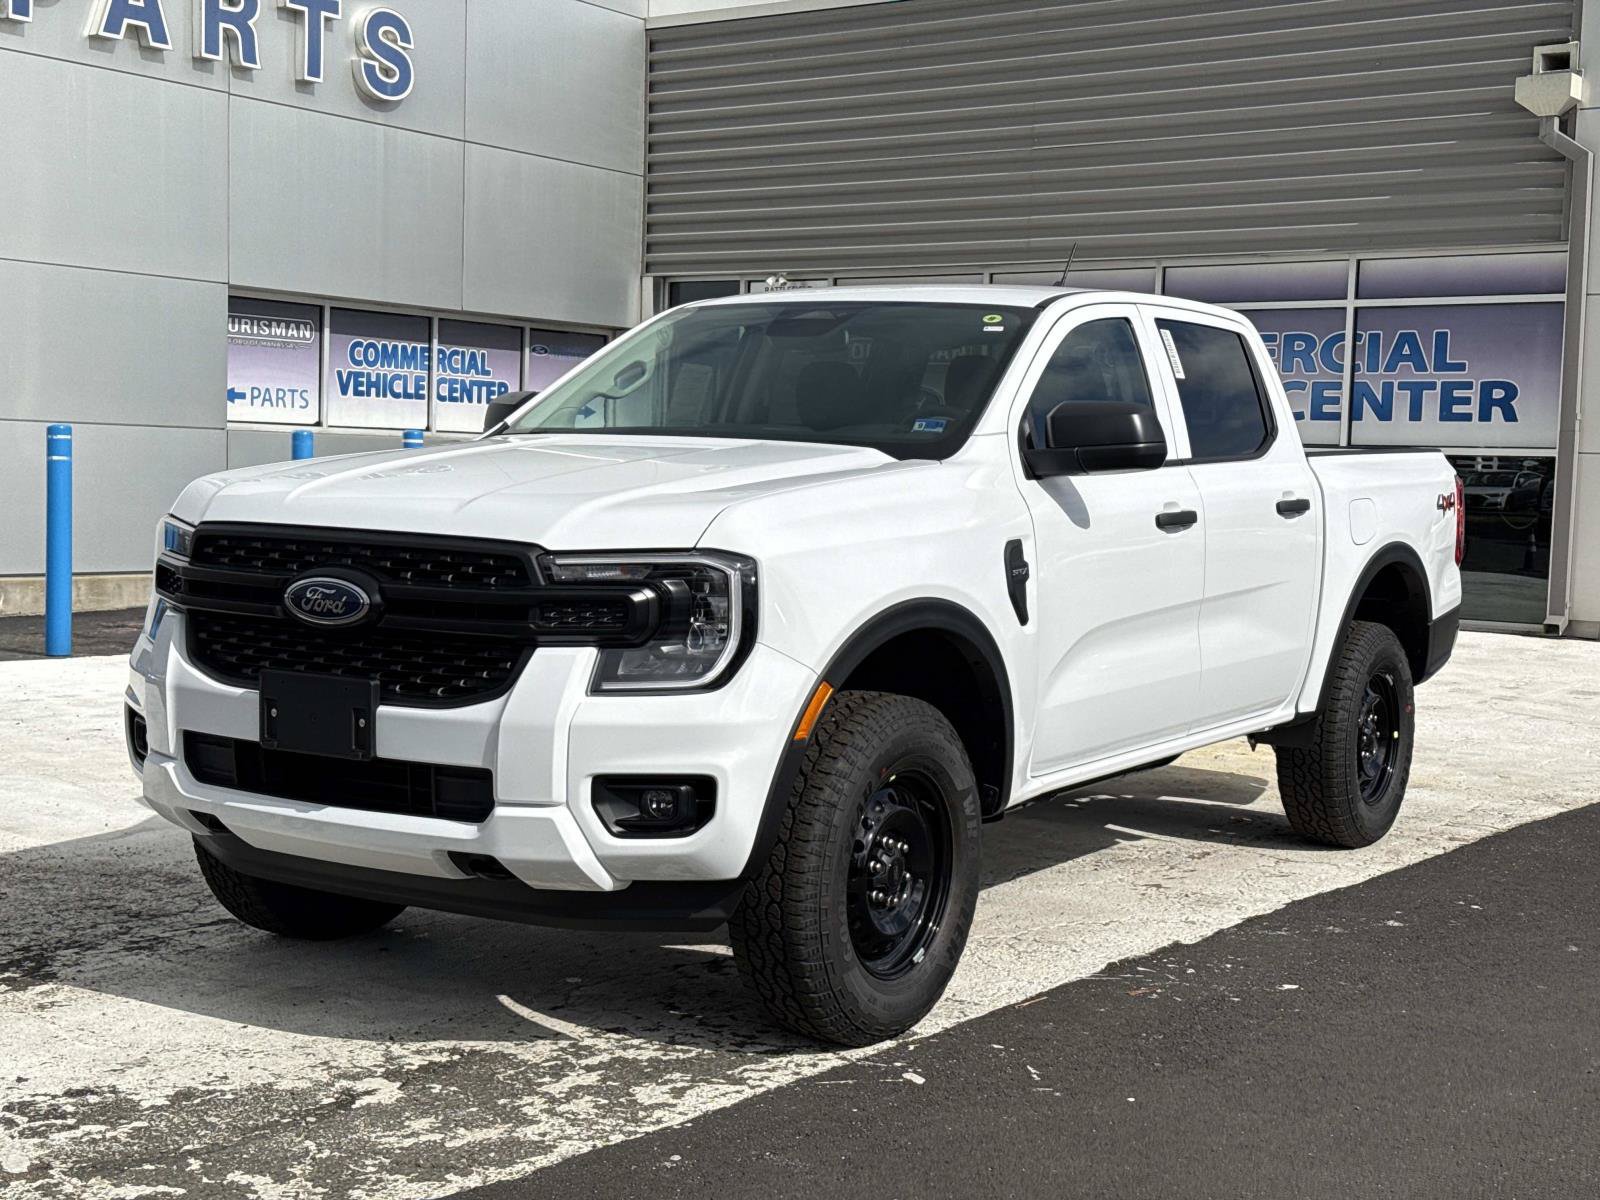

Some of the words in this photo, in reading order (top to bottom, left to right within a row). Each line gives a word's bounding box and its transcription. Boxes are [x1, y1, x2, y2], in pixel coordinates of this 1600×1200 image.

[348, 340, 492, 377] COMMERCIAL
[250, 386, 309, 410] PARTS
[336, 369, 427, 401] VEHICLE
[301, 586, 347, 614] Ford
